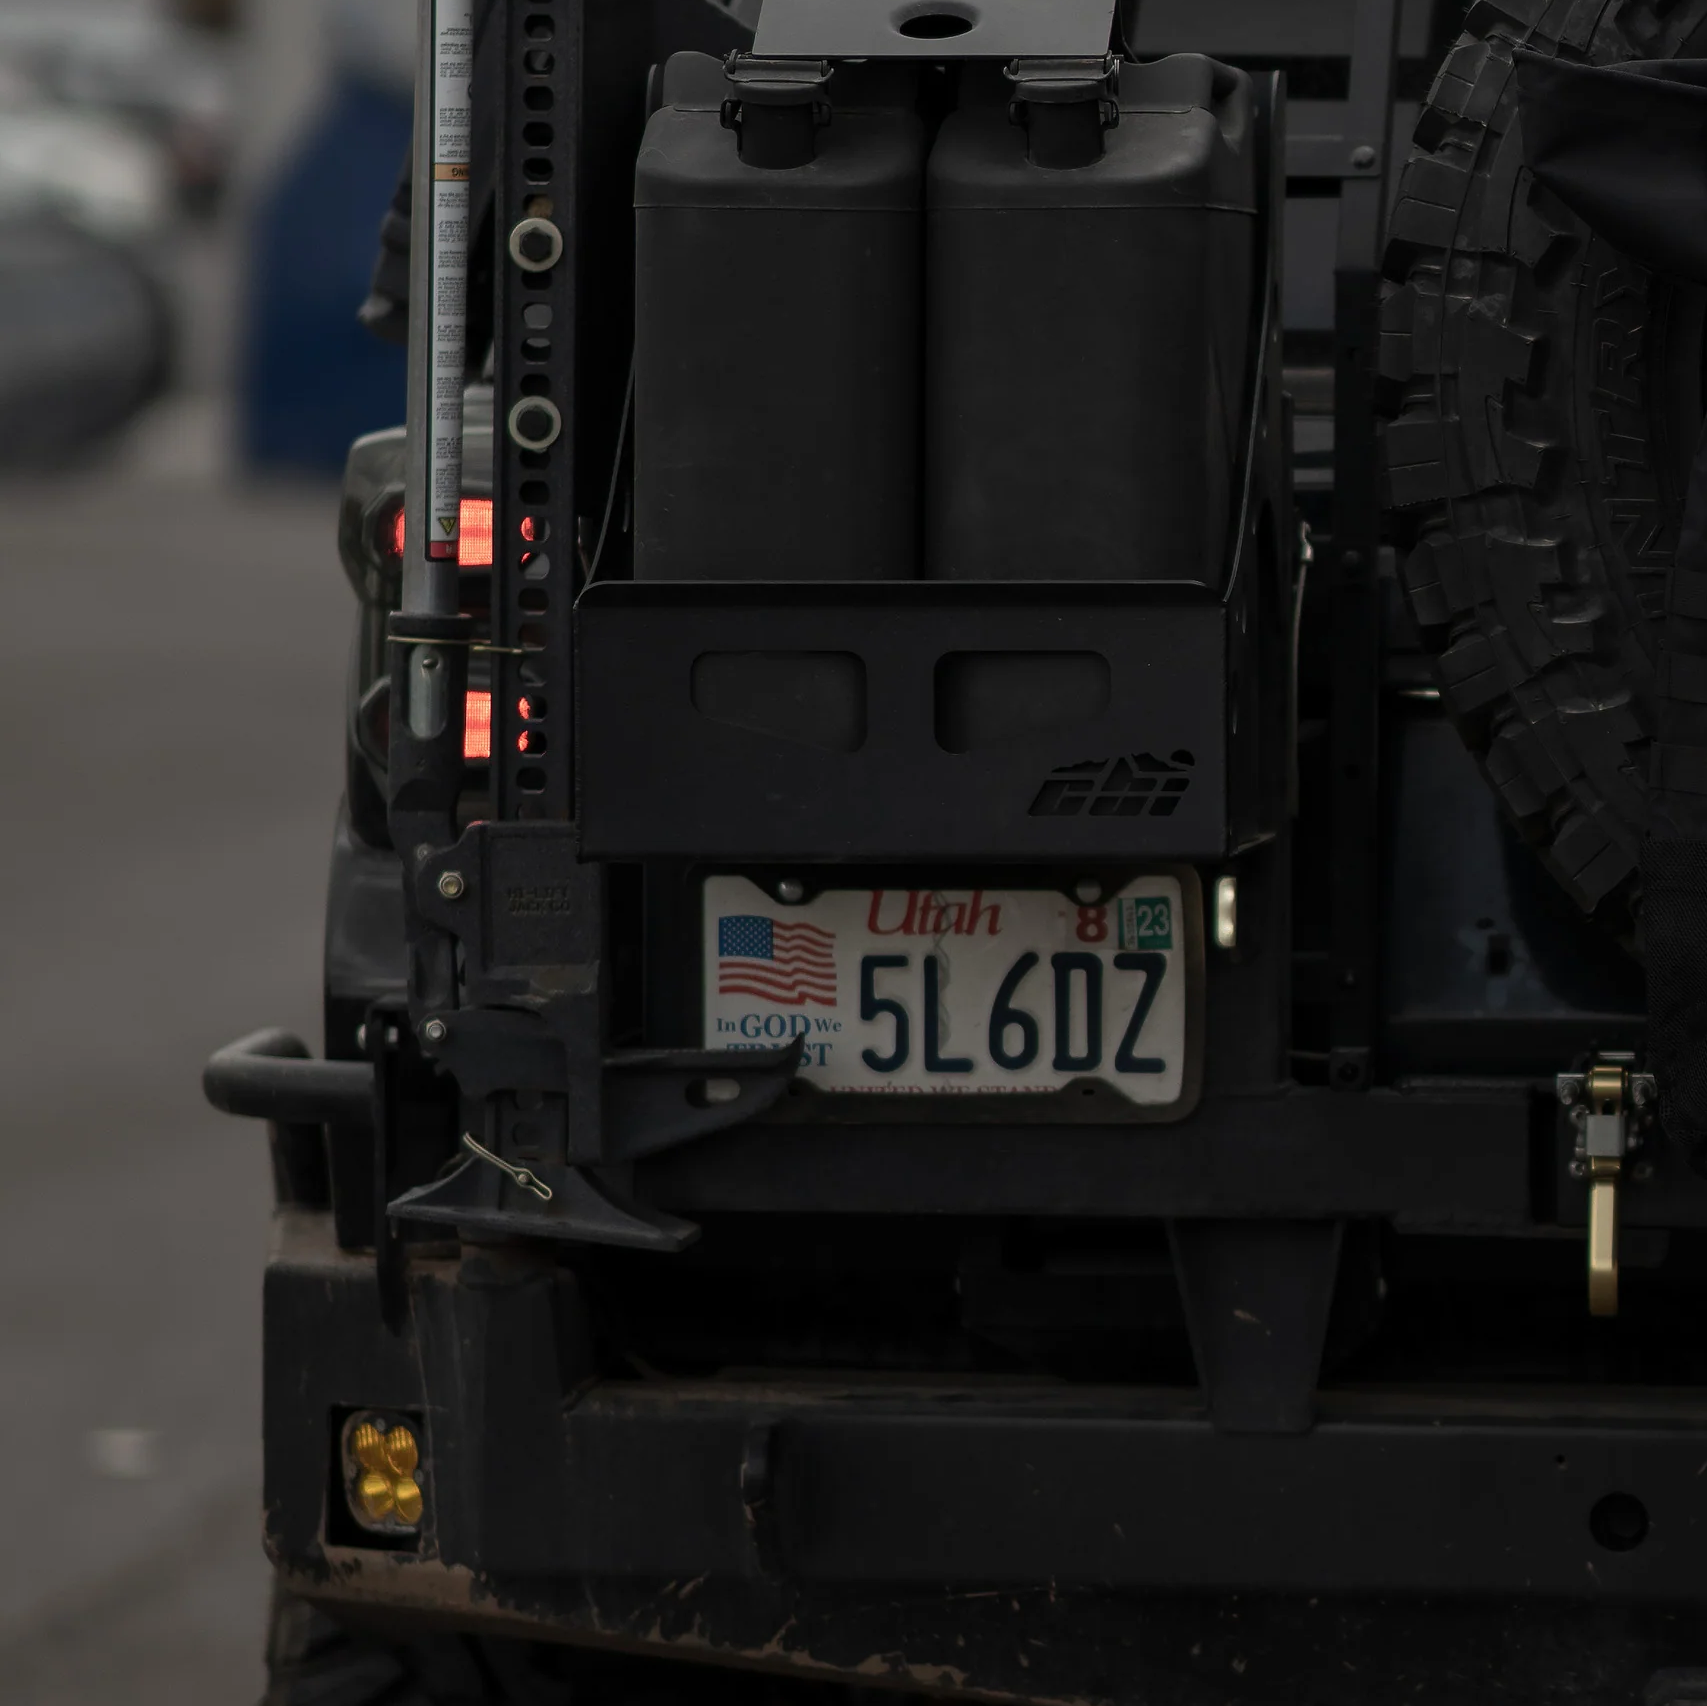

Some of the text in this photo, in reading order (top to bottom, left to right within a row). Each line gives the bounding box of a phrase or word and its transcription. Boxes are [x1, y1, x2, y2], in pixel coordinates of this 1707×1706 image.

[867, 888, 1003, 935] Utah
[1137, 903, 1170, 937] 23
[717, 1014, 842, 1038] In GOD We
[859, 951, 1168, 1074] 5L6DZ
